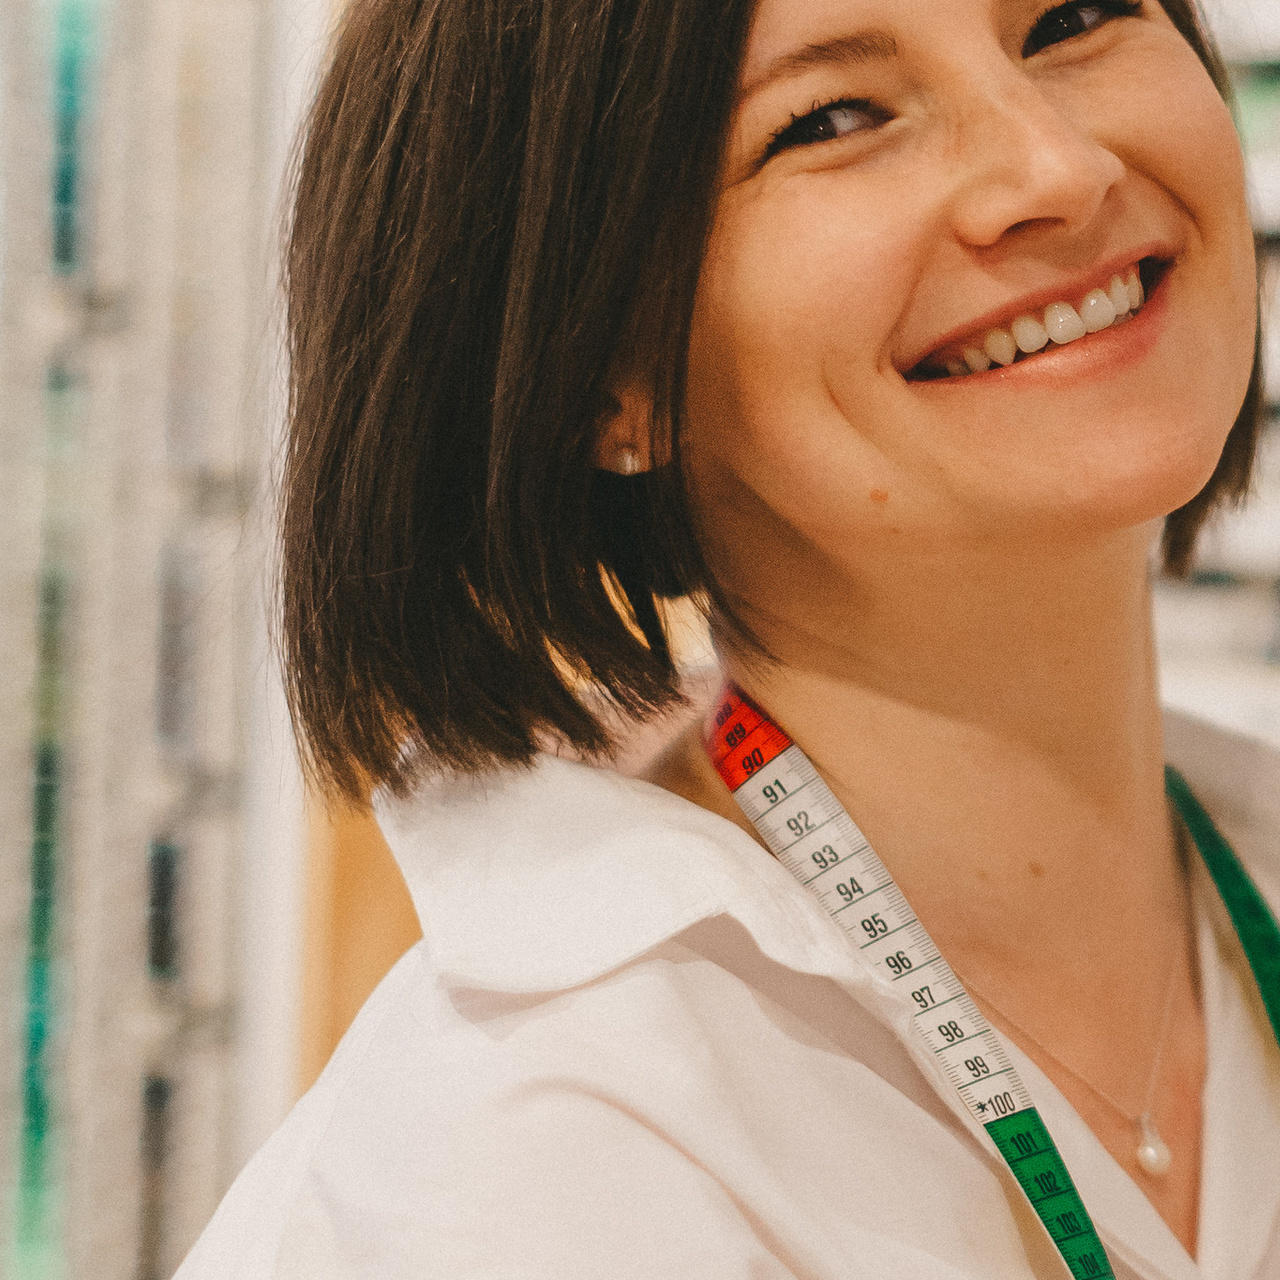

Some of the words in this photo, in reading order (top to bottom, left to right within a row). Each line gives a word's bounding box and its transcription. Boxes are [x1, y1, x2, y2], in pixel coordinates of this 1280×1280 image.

[726, 722, 746, 747] 89
[742, 748, 764, 775] 90
[762, 778, 788, 804] 91
[786, 810, 816, 837] 92
[811, 844, 840, 869] 93
[836, 876, 865, 902] 94
[860, 912, 888, 939] 95
[885, 950, 913, 974] 96
[911, 986, 936, 1009] 97
[938, 1020, 965, 1043] 98
[964, 1055, 990, 1078] 99
[1010, 1131, 1039, 1156] 101
[1034, 1171, 1060, 1196] 102
[1056, 1211, 1081, 1235] 103
[1077, 1253, 1099, 1276] 104
